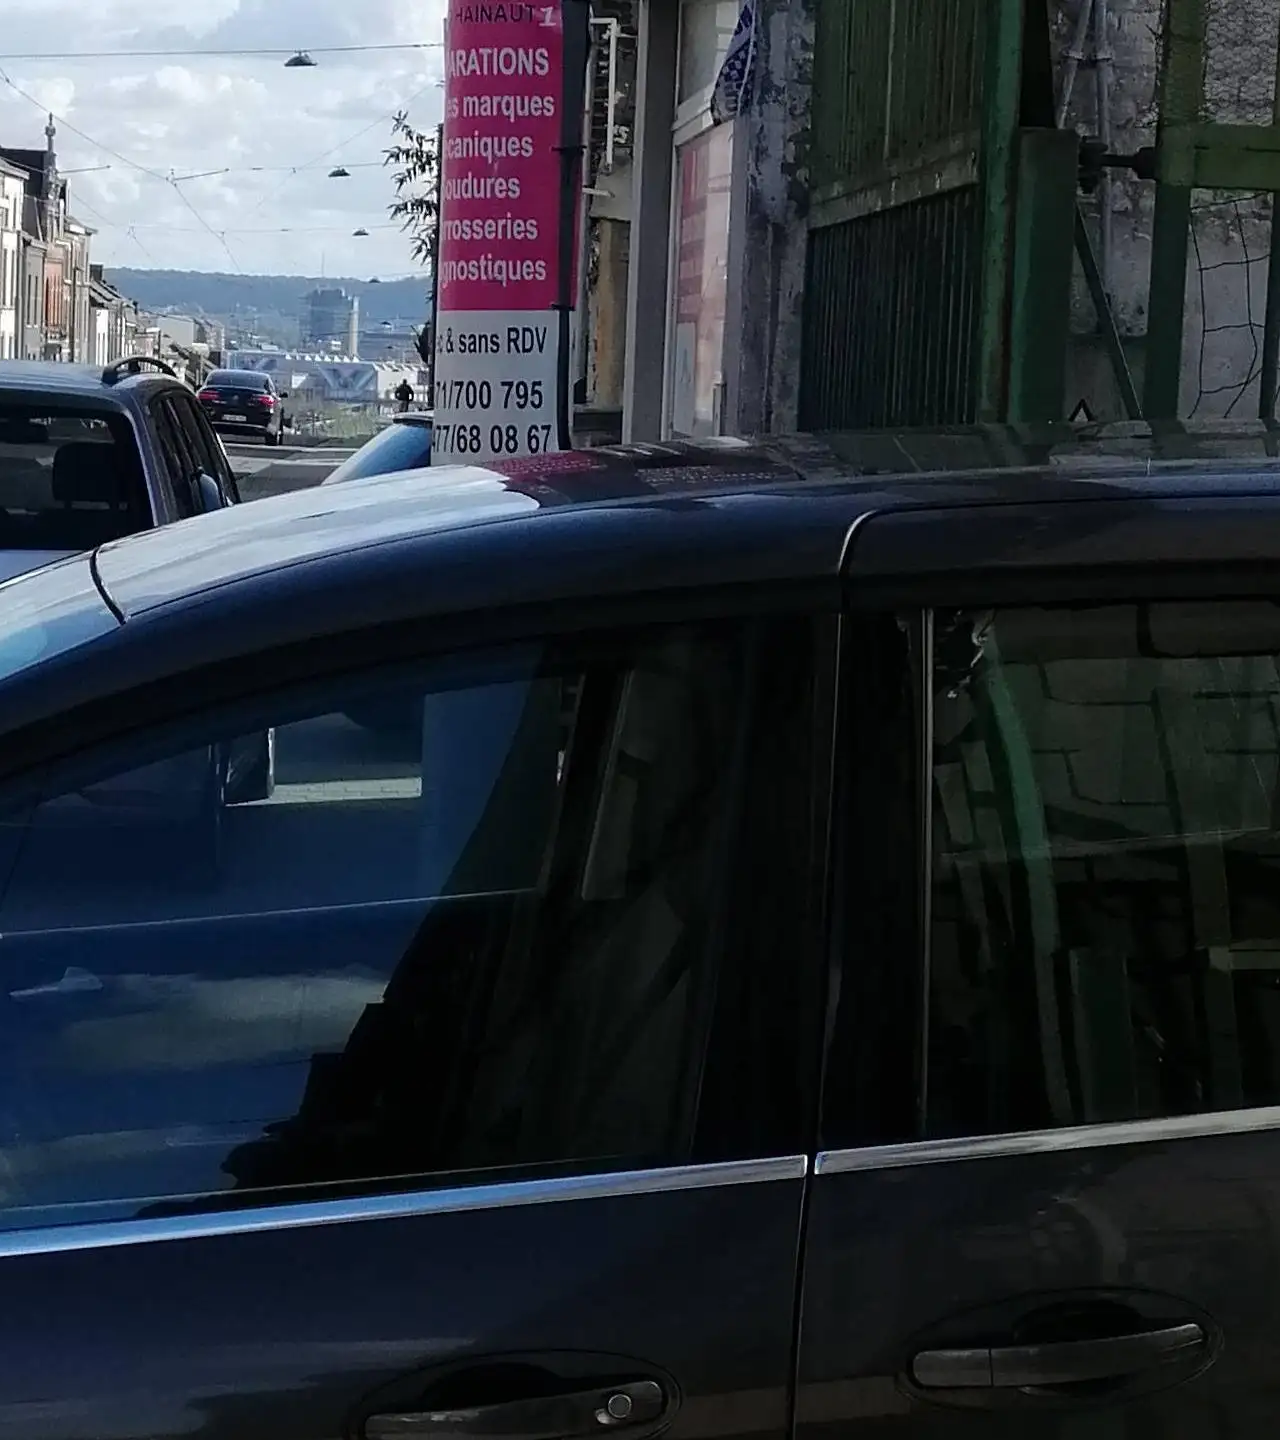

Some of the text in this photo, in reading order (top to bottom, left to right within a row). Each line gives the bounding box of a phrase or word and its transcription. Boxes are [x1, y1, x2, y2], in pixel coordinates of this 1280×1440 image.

[463, 95, 555, 123] marques
[446, 326, 454, 354] &
[458, 332, 500, 354] sans
[507, 326, 547, 354] RDV
[500, 380, 543, 410] 795
[490, 424, 519, 454] 08
[527, 424, 552, 454] 67
